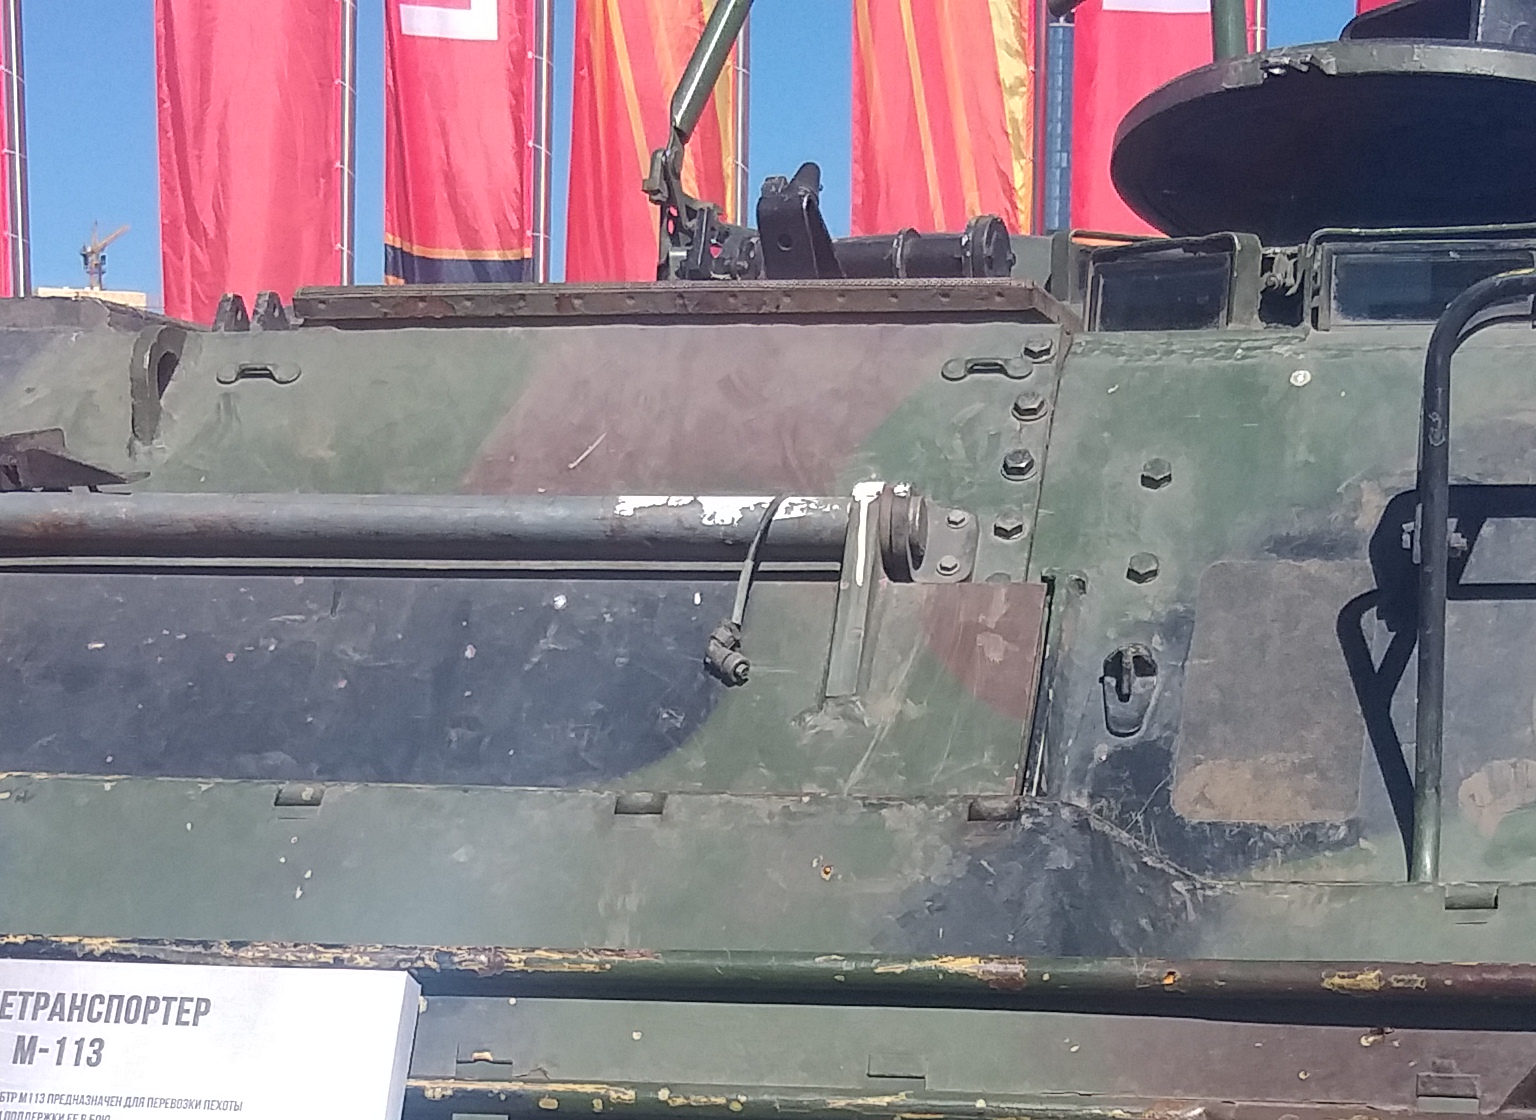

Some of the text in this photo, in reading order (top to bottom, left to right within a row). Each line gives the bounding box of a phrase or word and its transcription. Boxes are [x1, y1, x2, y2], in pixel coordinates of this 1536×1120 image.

[10, 1034, 106, 1067] М-113
[45, 1093, 123, 1107] ПРЕДНАЗНАЧЕН
[122, 1096, 146, 1108] ДЛЯ
[145, 1097, 202, 1110] ПЕРЕВОЗКИ
[202, 1099, 244, 1112] ПЕХОТЫ
